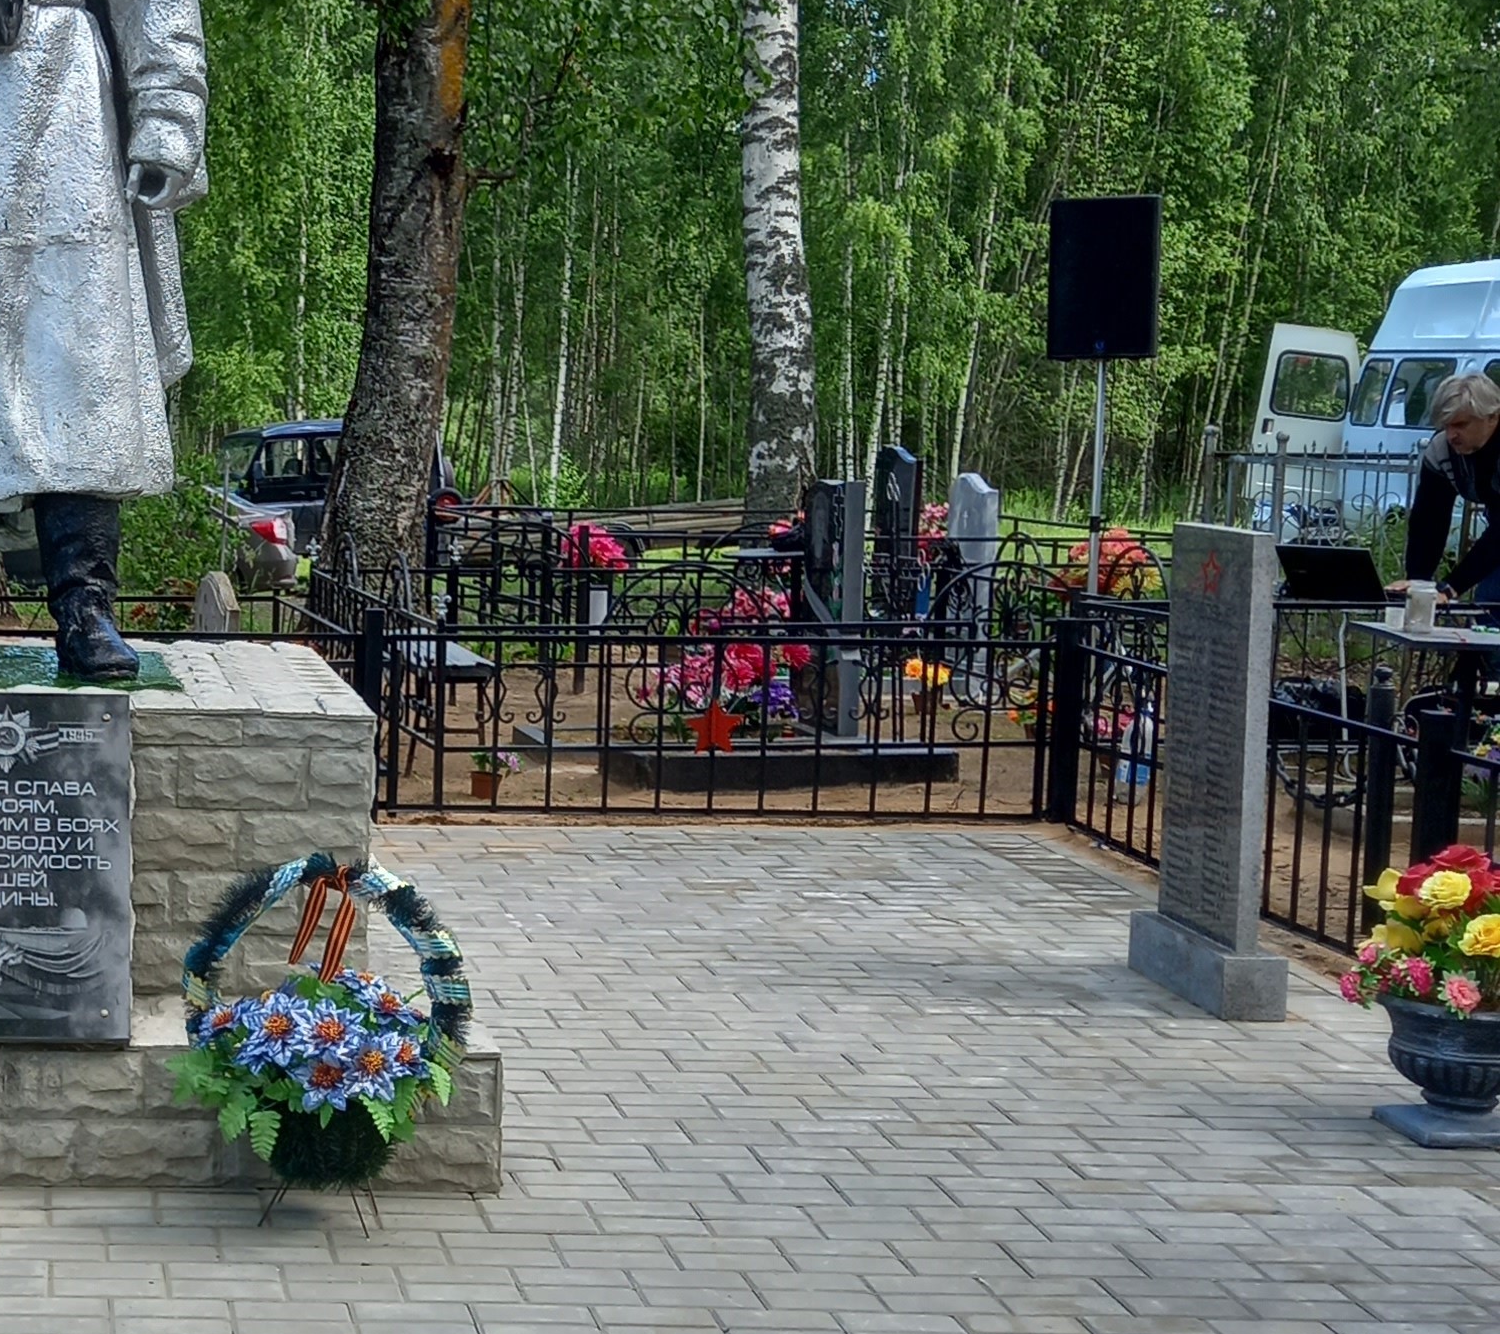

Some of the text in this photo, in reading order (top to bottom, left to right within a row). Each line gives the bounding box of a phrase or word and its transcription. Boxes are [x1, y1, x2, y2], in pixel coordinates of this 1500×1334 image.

[63, 727, 93, 742] 1945
[14, 779, 97, 797] СЛАВА
[34, 818, 51, 832] В
[57, 818, 120, 834] БОЯХ
[77, 836, 94, 851] И
